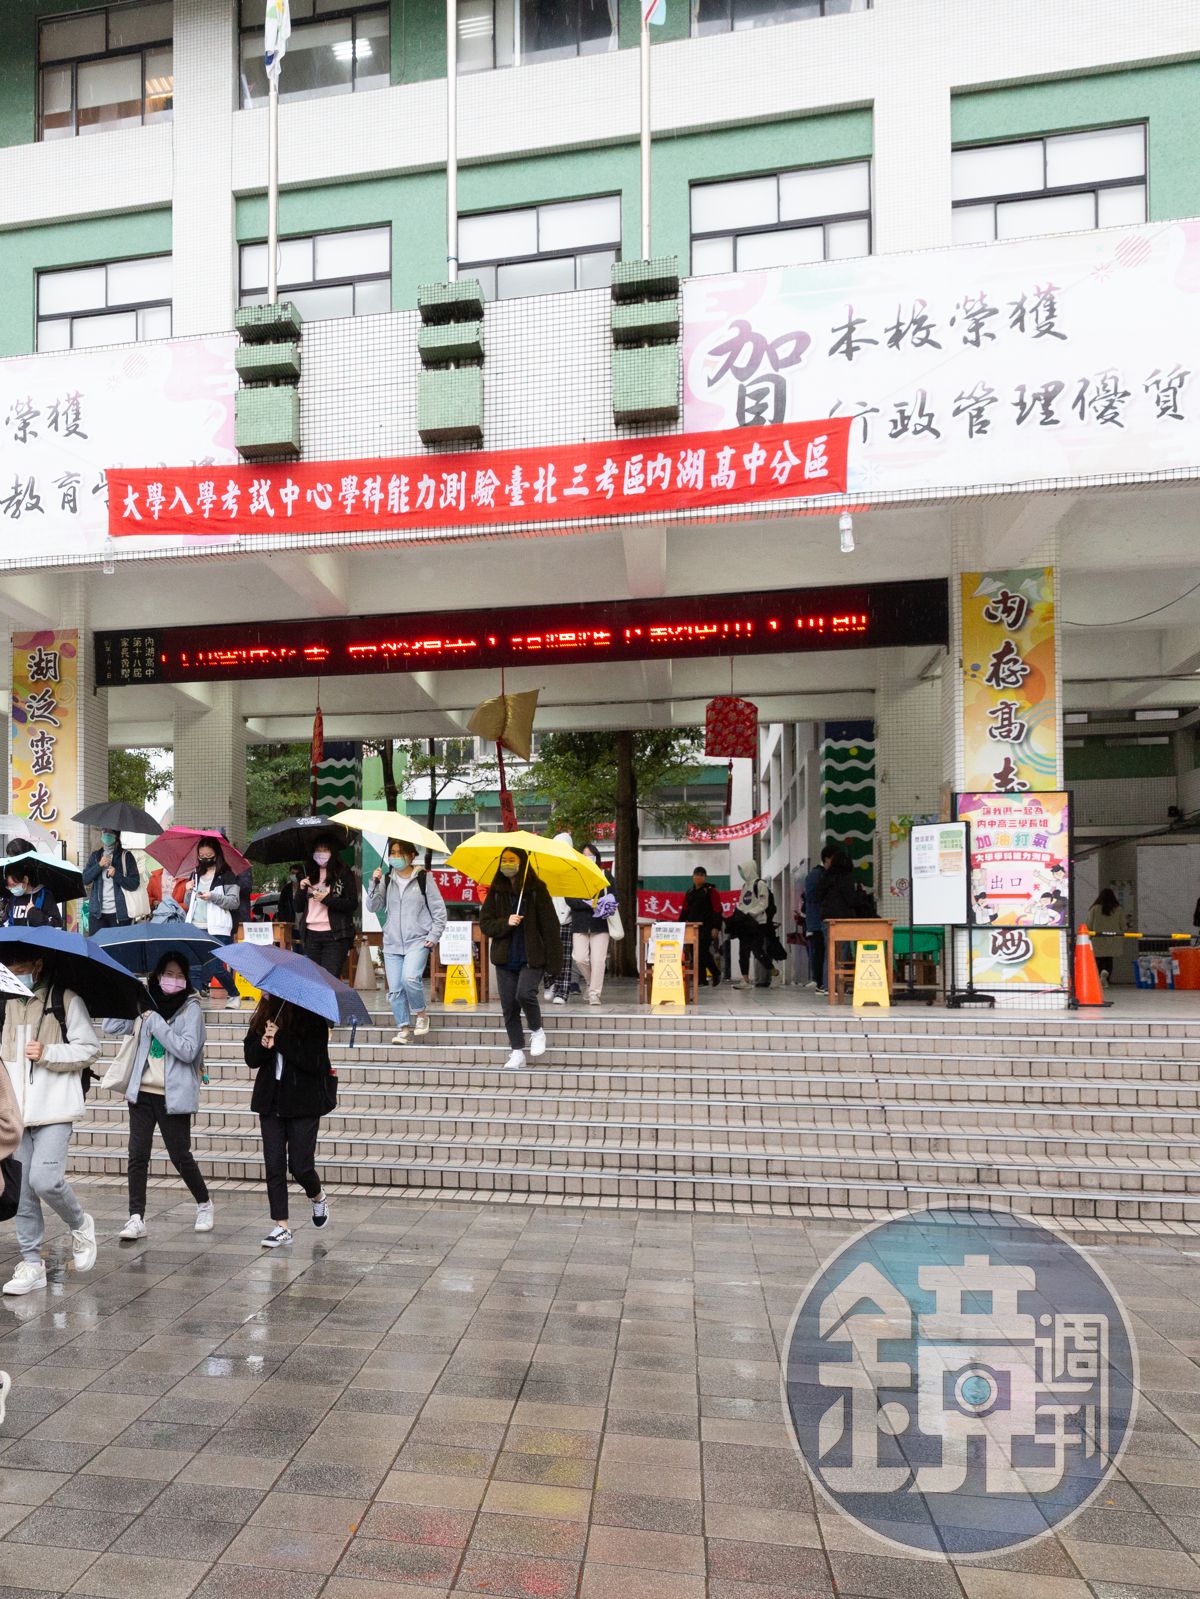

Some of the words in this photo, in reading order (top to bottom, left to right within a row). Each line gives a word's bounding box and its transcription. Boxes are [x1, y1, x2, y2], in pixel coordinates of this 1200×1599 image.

[827, 282, 1068, 361] 本校榮獲
[707, 320, 812, 426] 賀
[975, 831, 1049, 850] 加油打氣
[991, 875, 1022, 890] 出口
